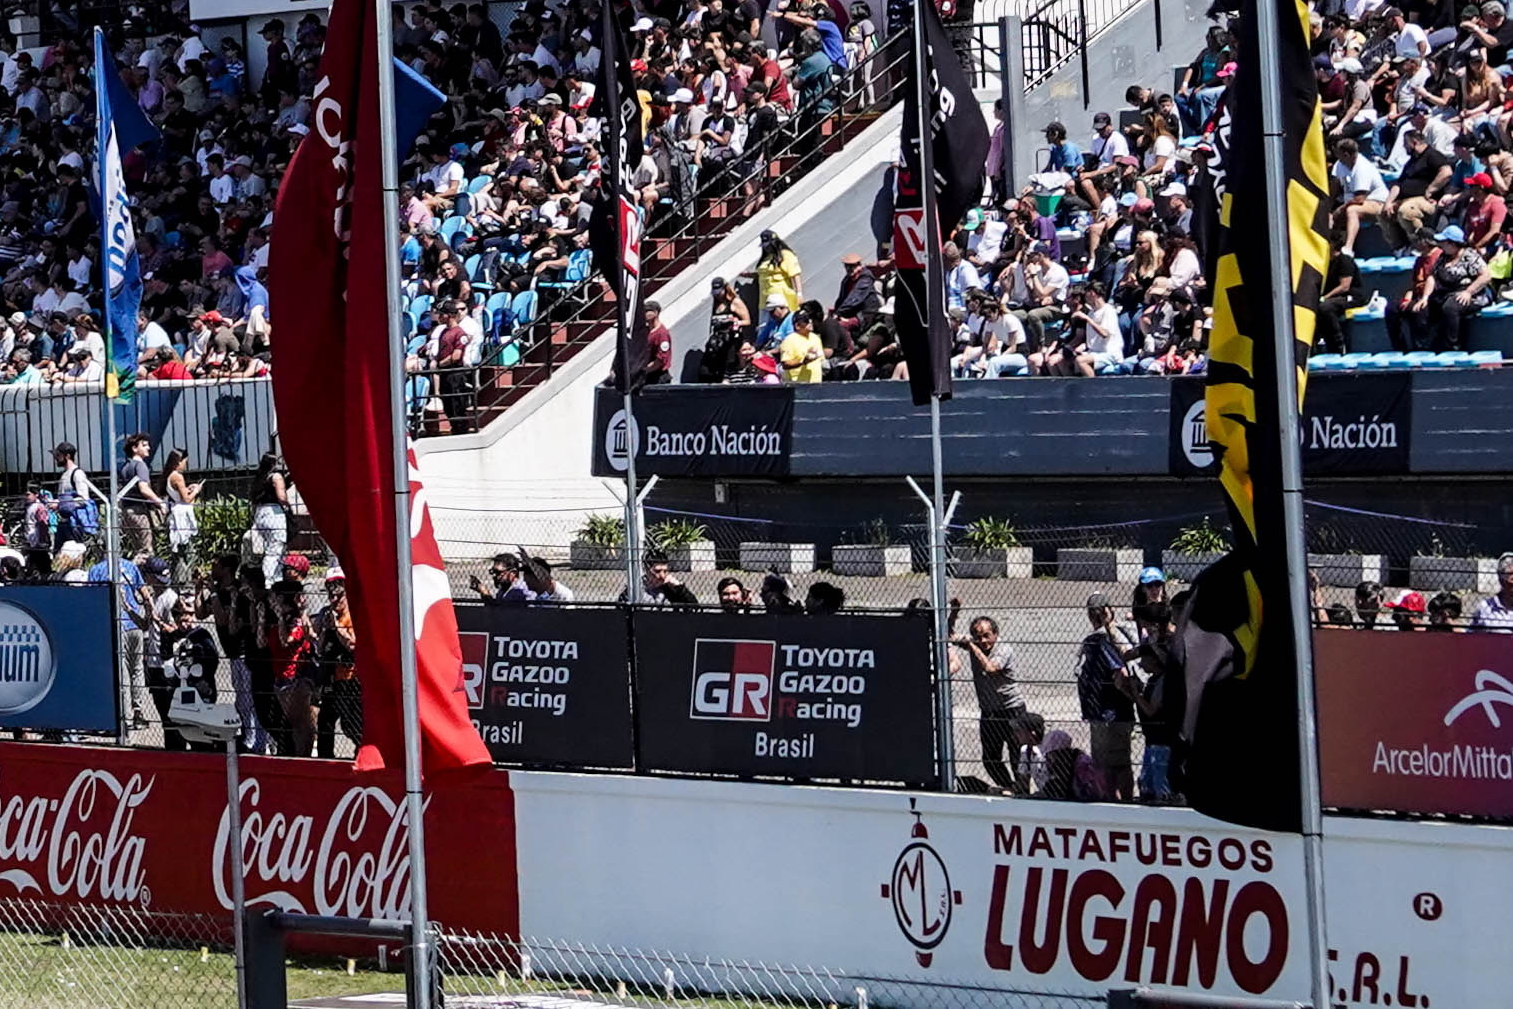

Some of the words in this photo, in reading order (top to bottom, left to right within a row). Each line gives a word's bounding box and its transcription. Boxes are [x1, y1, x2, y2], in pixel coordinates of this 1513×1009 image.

[646, 425, 706, 455] Banco
[710, 424, 781, 455] Nación
[1310, 415, 1398, 449] Nación
[493, 636, 578, 660] TOYOTA
[781, 644, 875, 668] TOYOTA
[492, 661, 569, 684] GAZOO
[780, 671, 865, 694] GAZOO
[491, 686, 566, 716] Racing
[695, 671, 770, 716] GR
[778, 696, 861, 727] Racing
[755, 732, 814, 758] Brasil
[1373, 741, 1513, 779] ArcelorMitta
[993, 823, 1273, 873] MATAFUEGOS
[984, 865, 1288, 994] LUGANO
